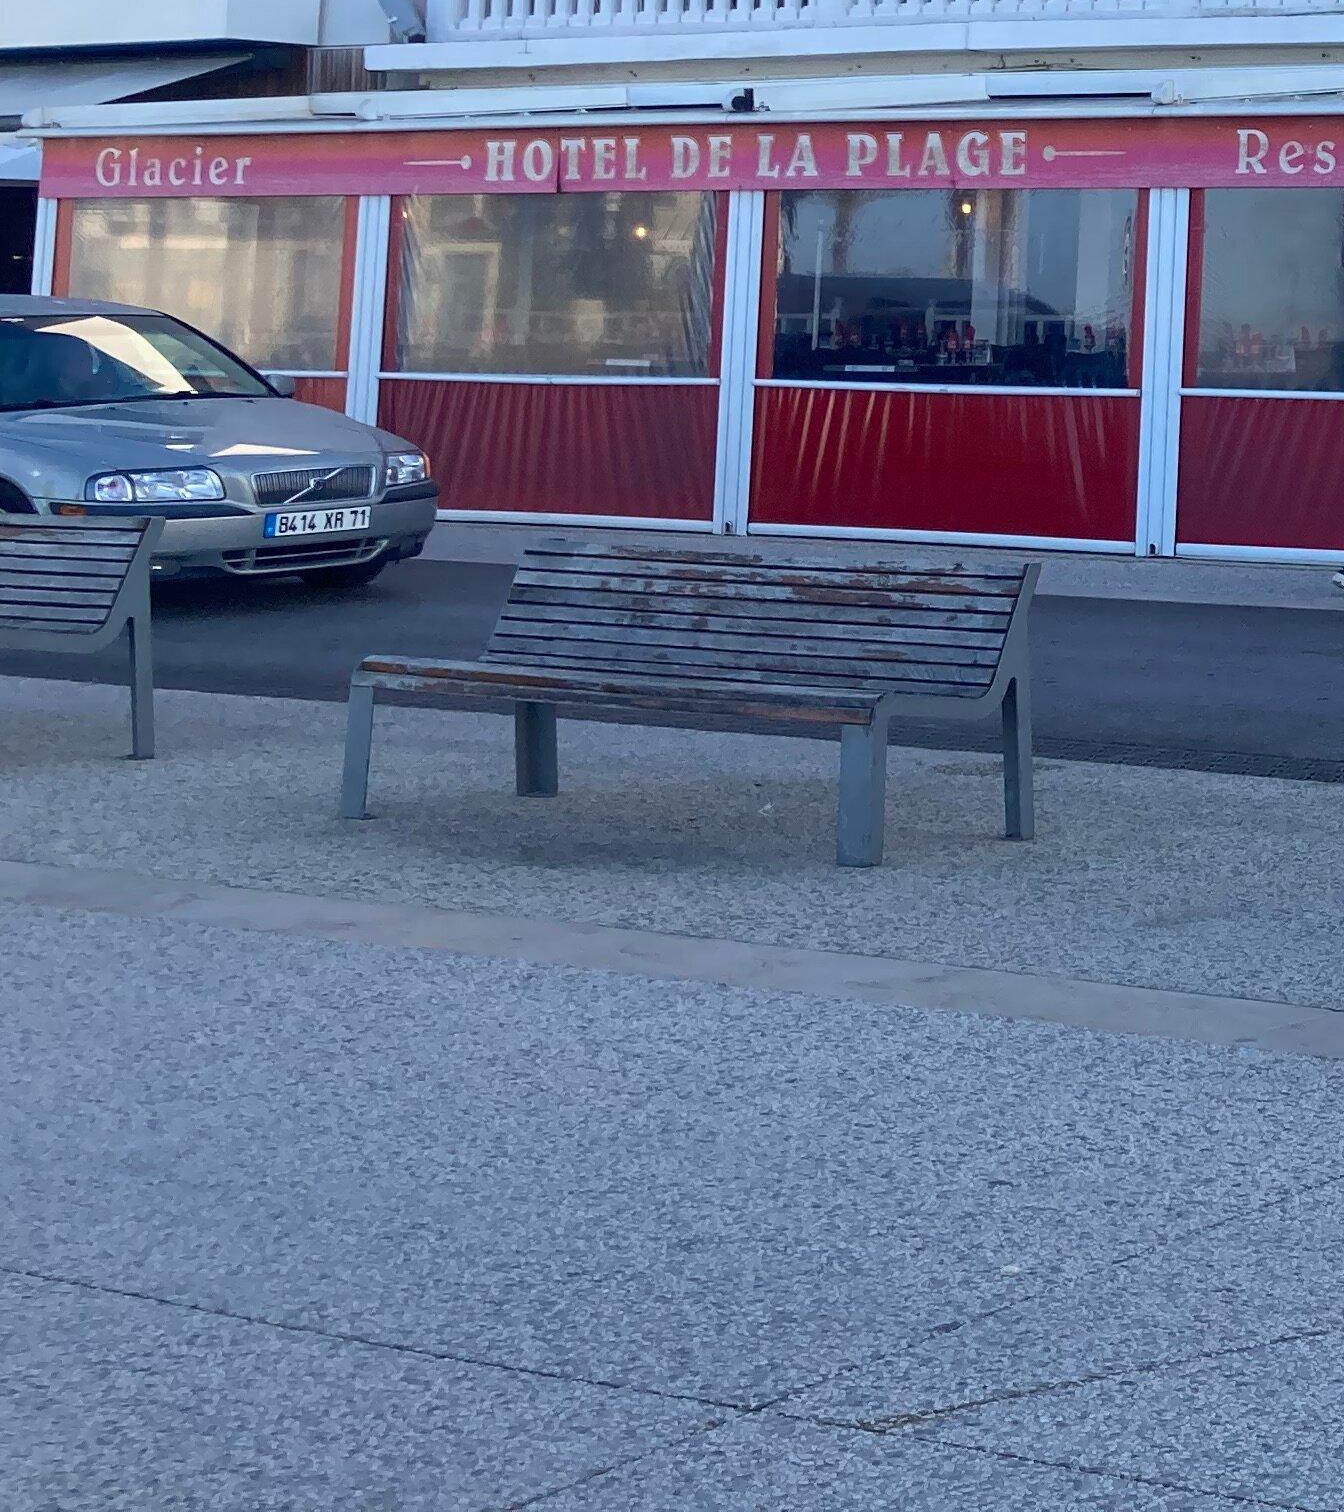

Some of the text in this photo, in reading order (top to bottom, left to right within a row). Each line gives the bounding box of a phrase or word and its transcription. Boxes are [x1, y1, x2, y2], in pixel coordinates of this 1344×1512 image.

[96, 146, 252, 186] Glacier
[484, 131, 1028, 182] HOTEL DE LA PLAGE
[278, 509, 367, 534] 8414 XR 71
